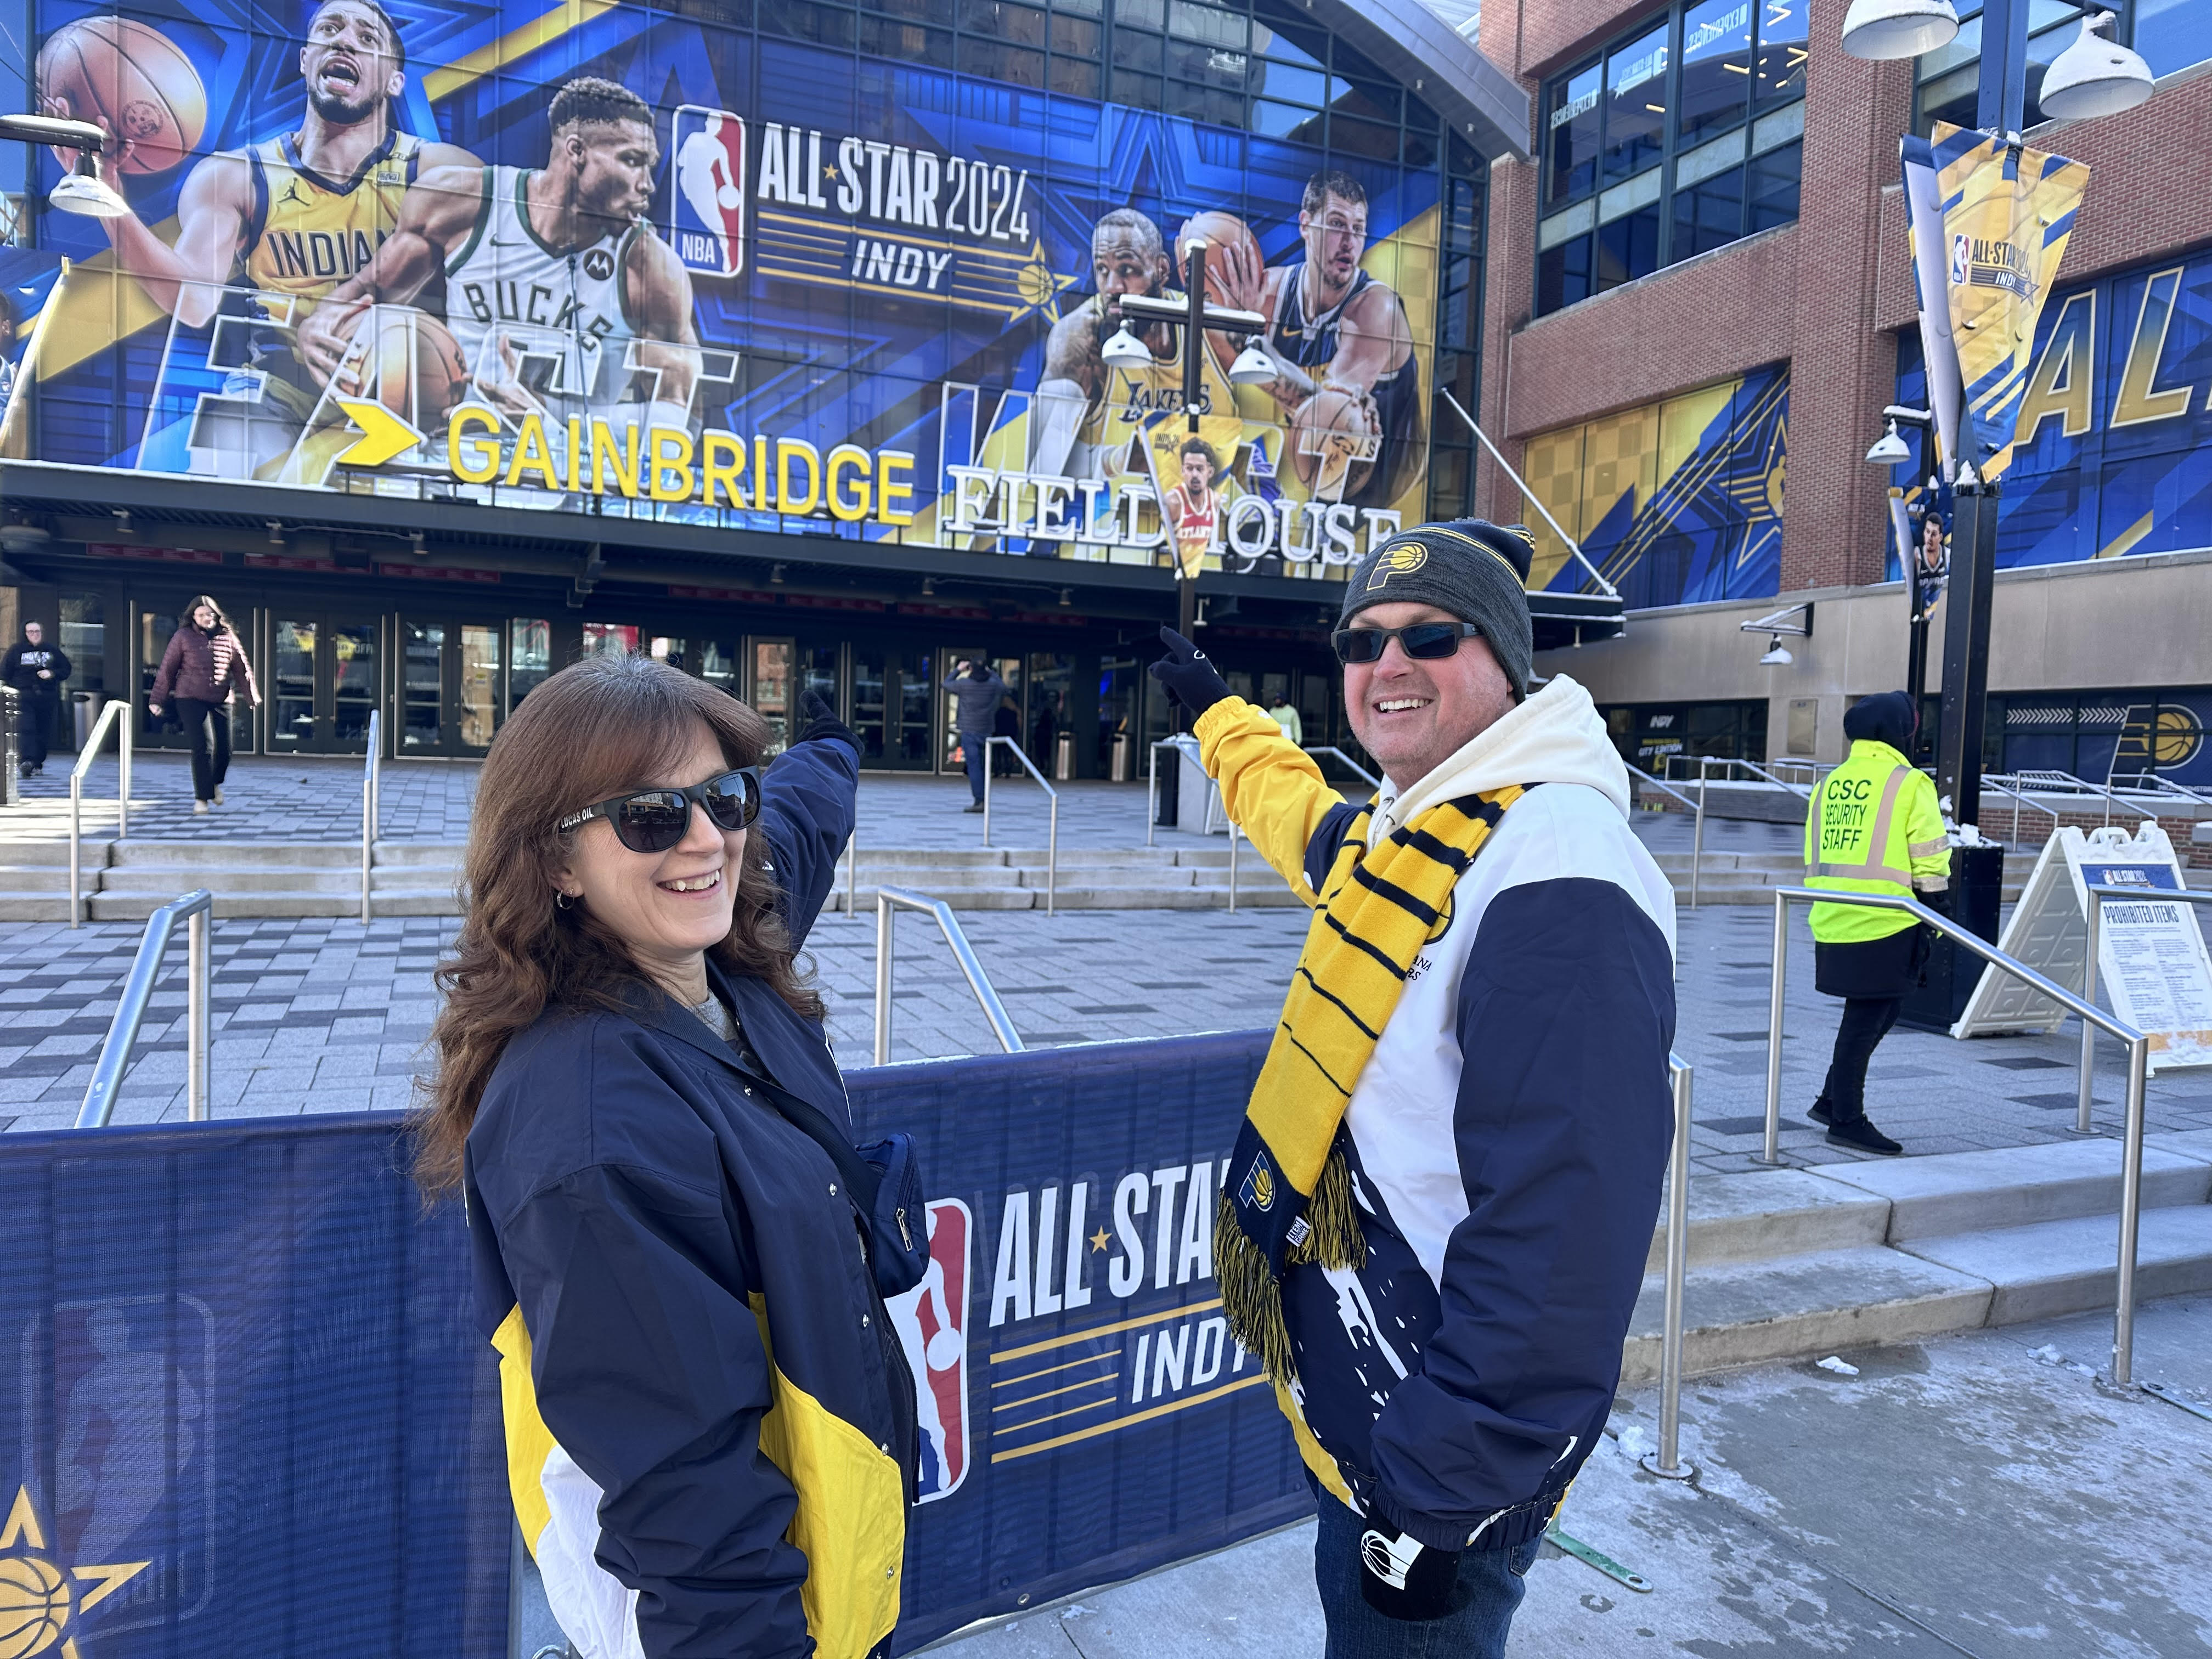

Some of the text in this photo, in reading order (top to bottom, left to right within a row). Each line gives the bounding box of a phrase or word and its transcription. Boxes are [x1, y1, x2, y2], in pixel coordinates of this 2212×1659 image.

[945, 156, 1030, 243] 2024
[682, 233, 716, 264] NBA
[851, 239, 953, 290] INDY
[1995, 272, 2017, 288] INDY
[463, 280, 614, 352] BUCKS
[2014, 266, 2212, 447] AL
[1118, 382, 1214, 422] LAKES
[447, 403, 916, 527] GAINBRIDGE
[943, 464, 1402, 567] FIELDOUSE
[1828, 780, 1872, 800] CSC
[561, 811, 581, 829] LUCAS
[1826, 803, 1867, 826] SECURITY
[1822, 828, 1863, 850] STAFF
[2103, 905, 2180, 924] PROHIBITED ITEMS
[1108, 1158, 1232, 1298] STA
[1287, 1220, 1304, 1239] ITEM
[1295, 1227, 1310, 1244] GAME
